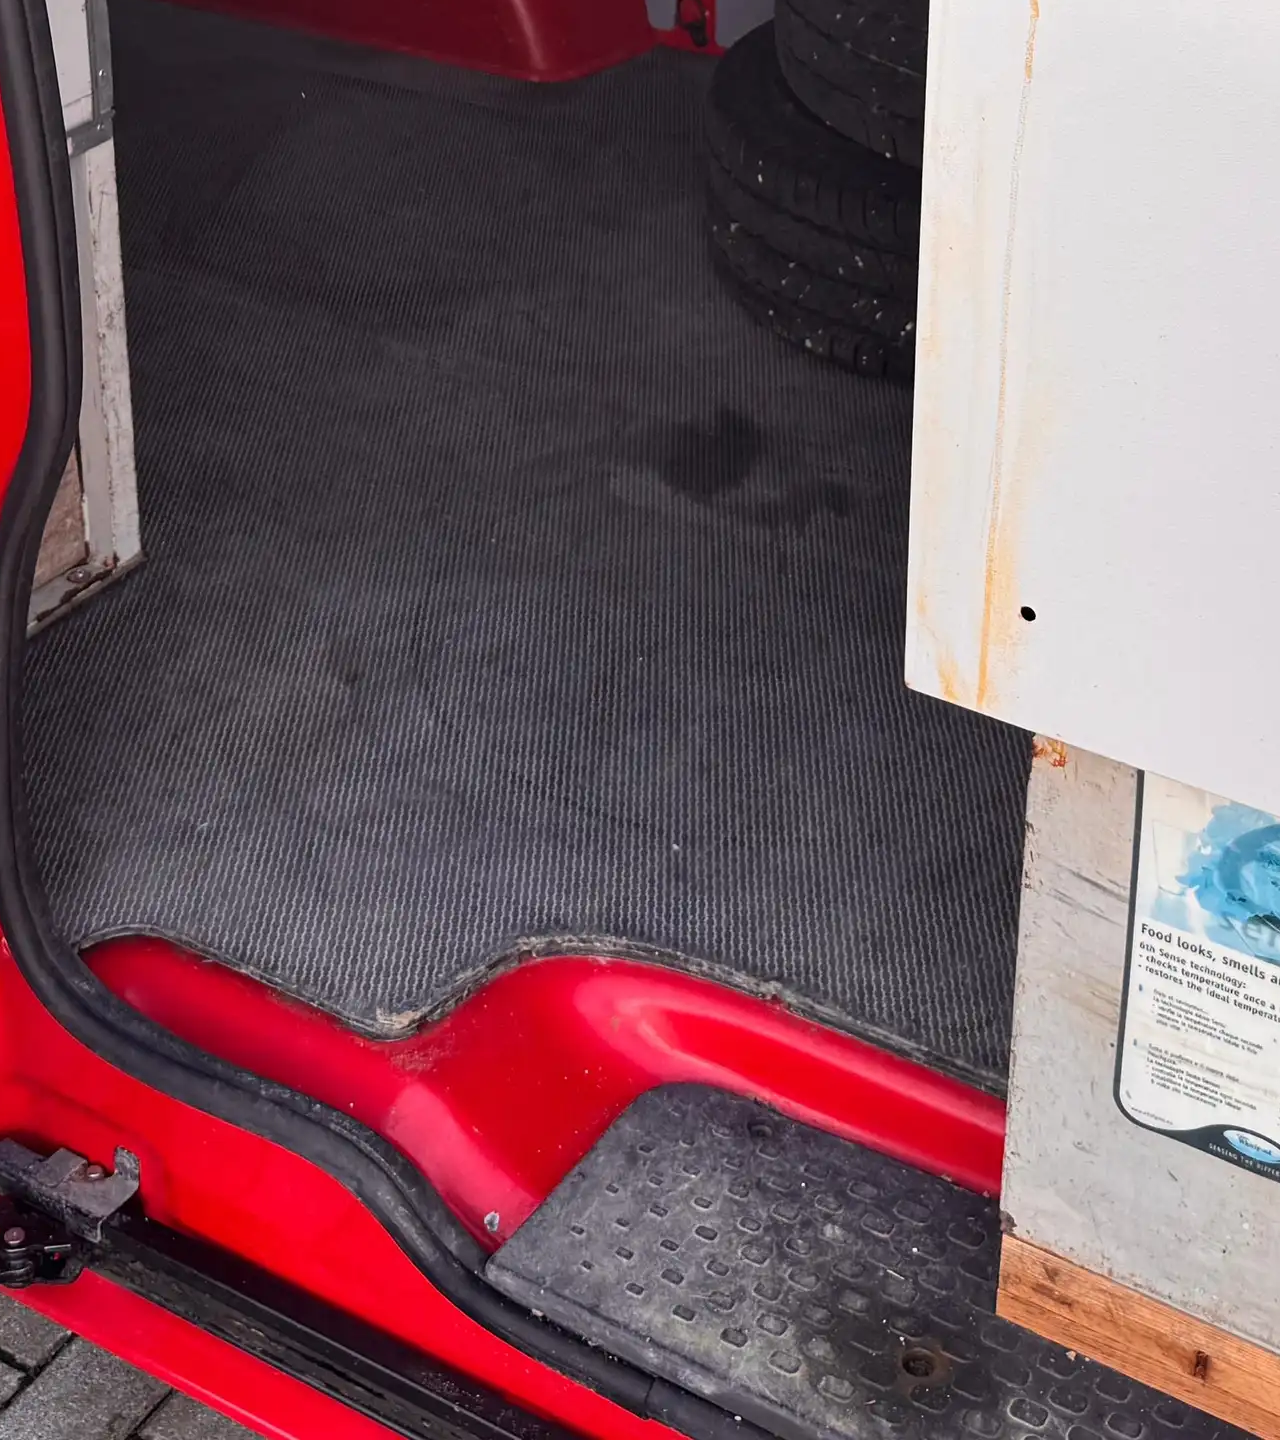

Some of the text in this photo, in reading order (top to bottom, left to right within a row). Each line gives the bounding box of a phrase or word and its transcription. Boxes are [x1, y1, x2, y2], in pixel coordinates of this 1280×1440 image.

[1139, 941, 1247, 989] 6th Sense technology:
[1140, 923, 1172, 943] Food
[1177, 936, 1217, 962] looks,
[1222, 955, 1266, 980] smells
[1145, 954, 1178, 972] checks
[1181, 968, 1241, 997] temperature
[1243, 993, 1266, 1008] once
[1269, 1003, 1276, 1011] a
[1145, 965, 1183, 985] restores
[1186, 979, 1202, 993] the
[1206, 989, 1230, 1004] ideal
